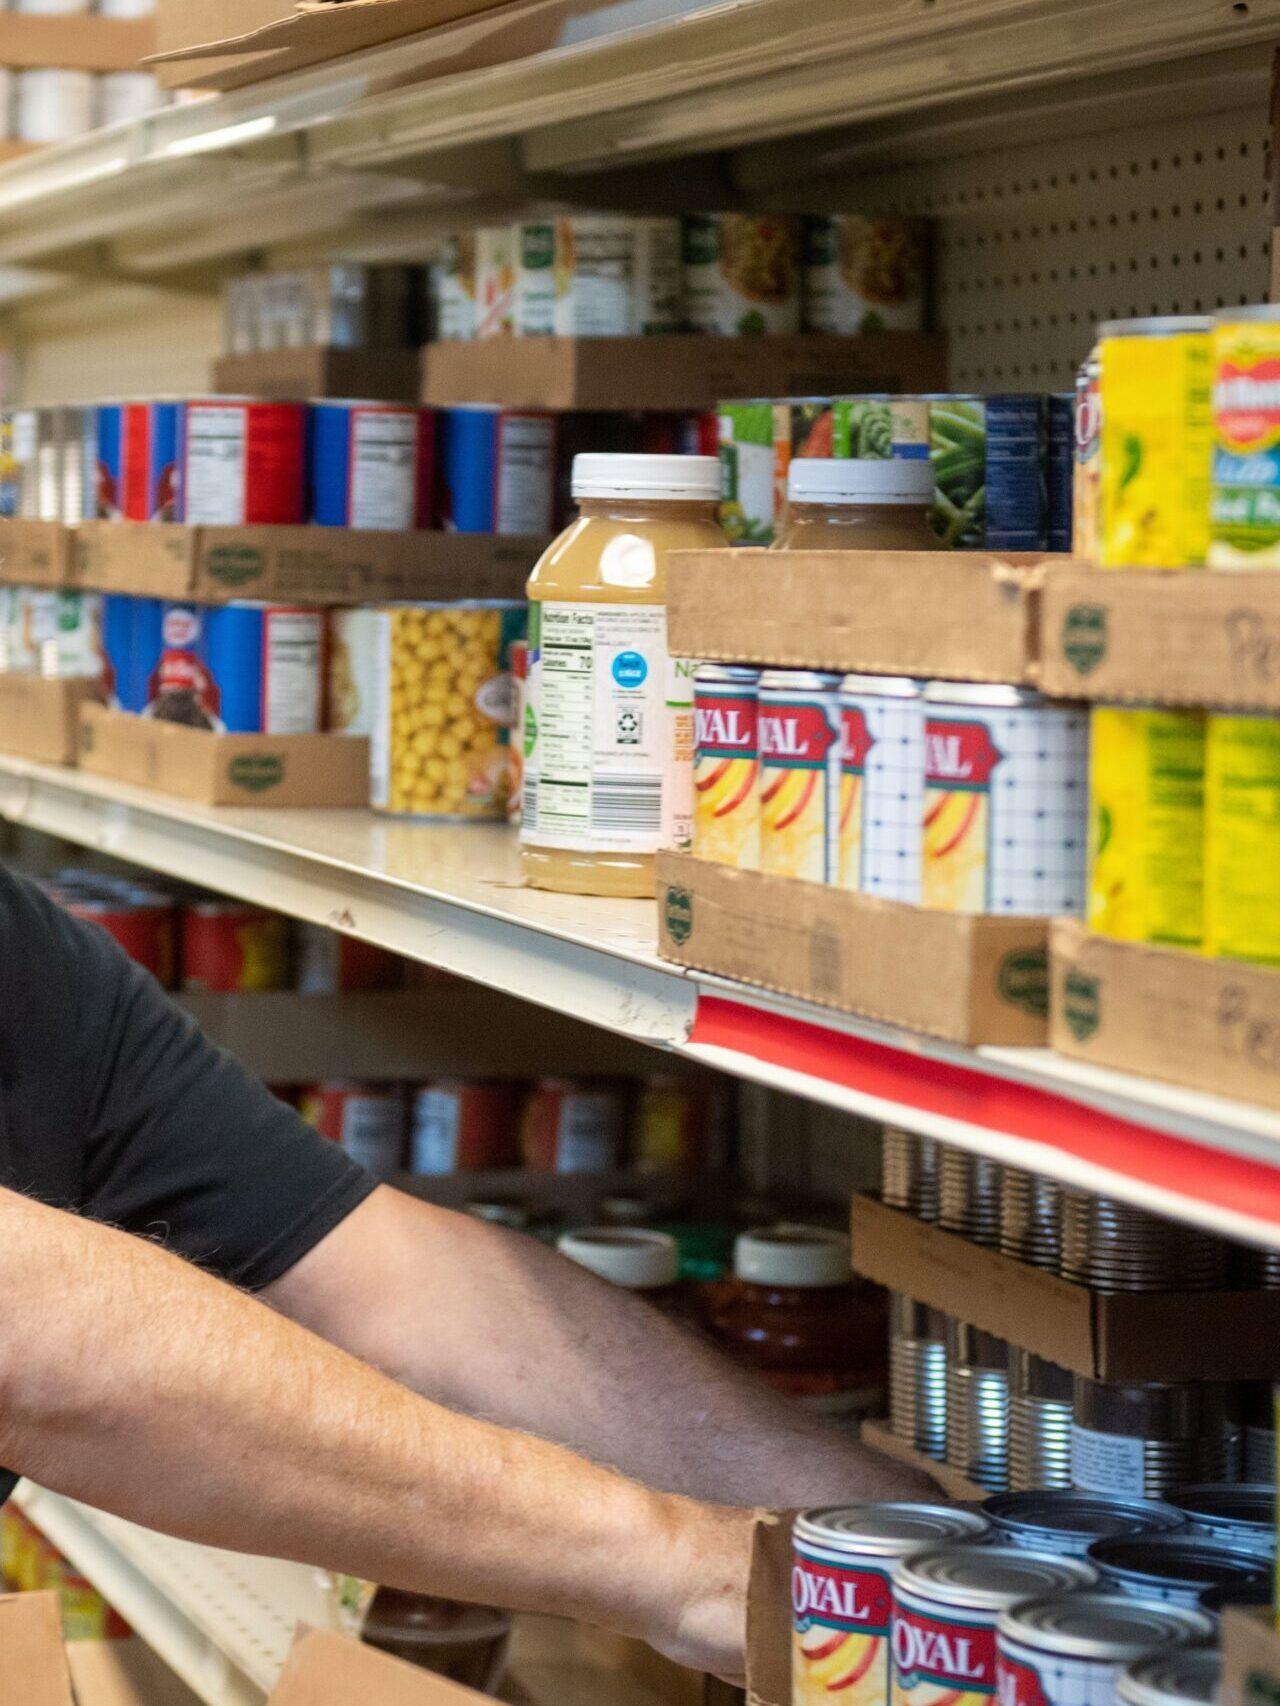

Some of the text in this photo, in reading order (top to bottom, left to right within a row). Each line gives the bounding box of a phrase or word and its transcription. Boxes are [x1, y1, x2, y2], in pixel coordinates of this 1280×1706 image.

[573, 612, 593, 625] Facts
[580, 655, 592, 669] 70
[791, 1566, 870, 1619] OYAL
[892, 1618, 985, 1678] OYAL
